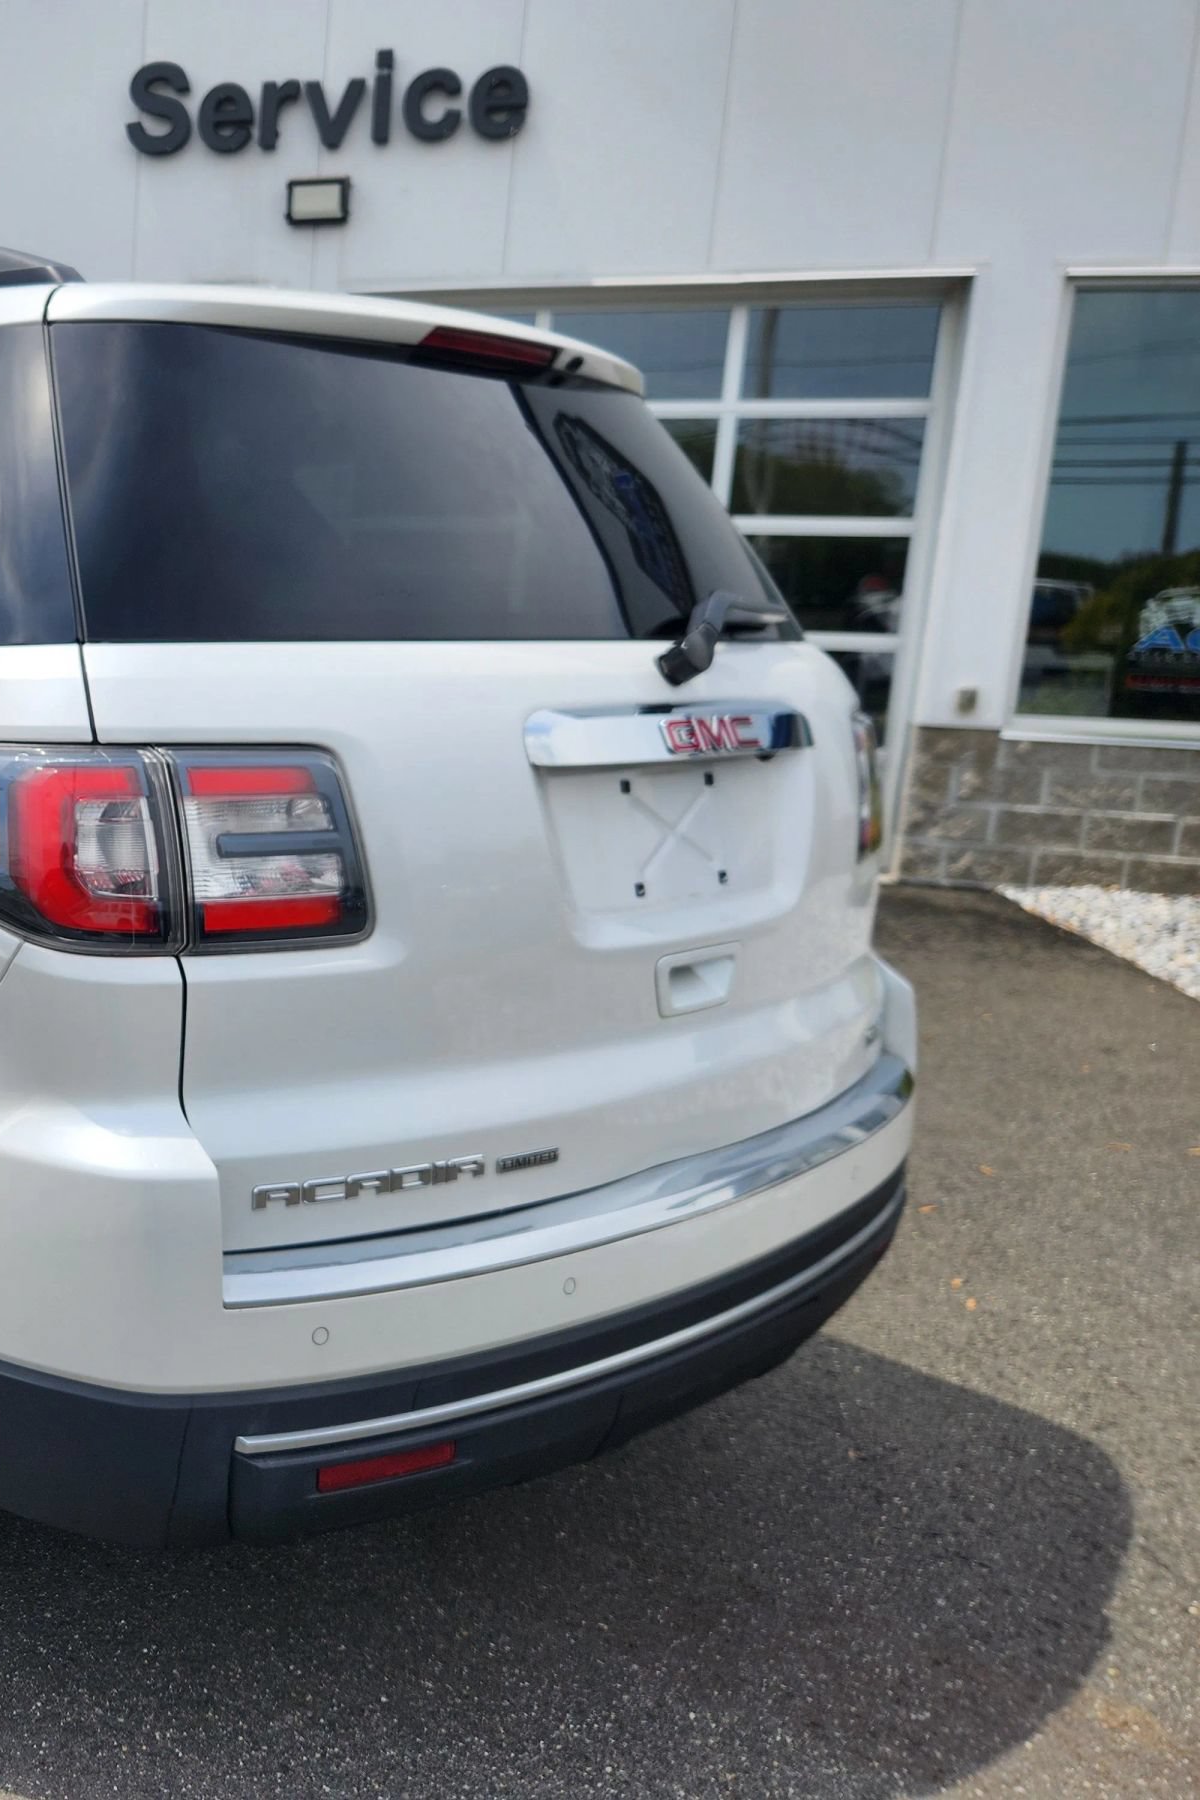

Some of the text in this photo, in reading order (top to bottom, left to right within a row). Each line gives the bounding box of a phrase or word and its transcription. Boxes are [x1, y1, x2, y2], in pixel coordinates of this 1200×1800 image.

[126, 49, 530, 157] Service
[659, 715, 761, 754] GMC
[251, 1153, 486, 1211] ACADIA
[498, 1146, 559, 1172] LIMITED
